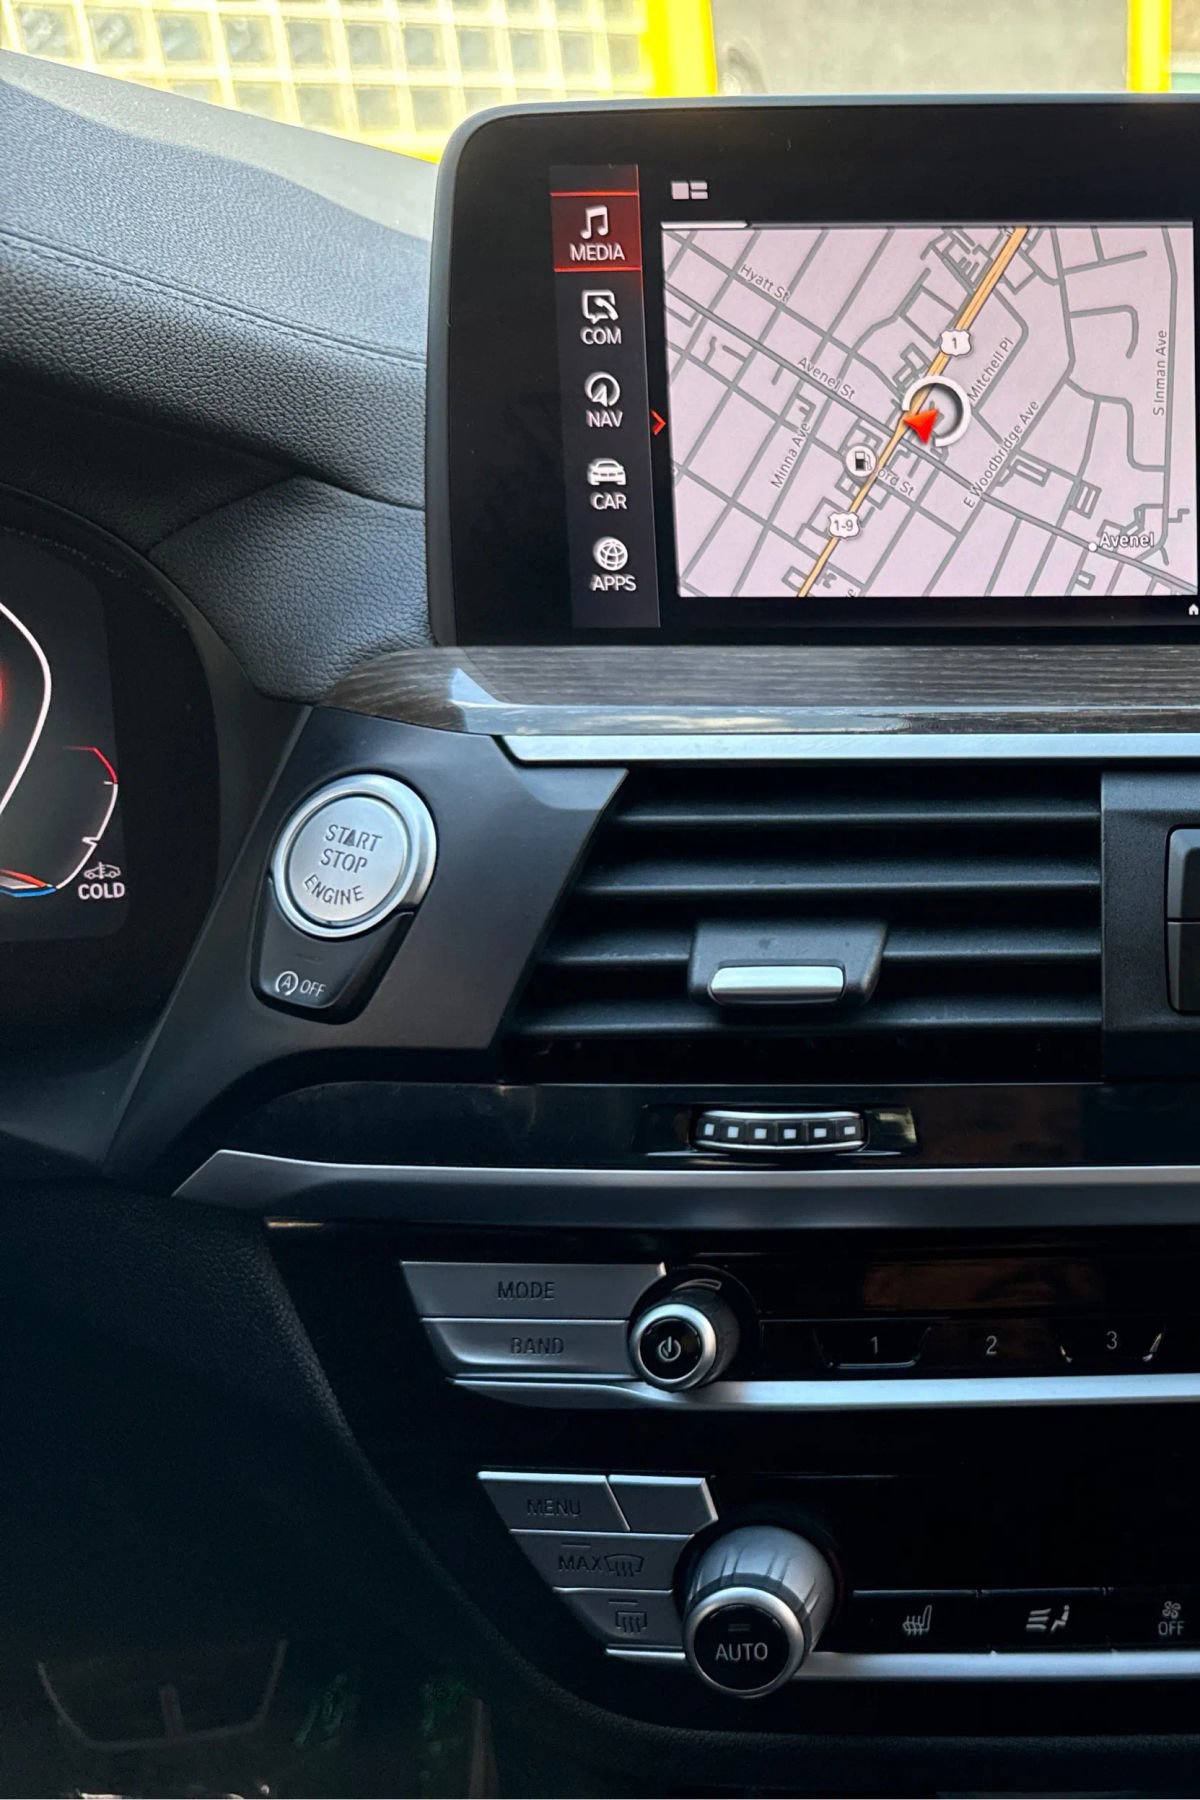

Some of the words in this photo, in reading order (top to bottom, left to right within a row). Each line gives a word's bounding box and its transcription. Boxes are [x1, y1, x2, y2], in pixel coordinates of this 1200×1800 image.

[569, 243, 626, 262] MEDIA
[739, 263, 773, 292] Hyatt
[770, 284, 790, 302] St
[580, 327, 622, 345] COM
[951, 336, 958, 350] 1
[1155, 329, 1168, 357] Ave
[797, 356, 841, 391] Avenel
[838, 384, 856, 401] St
[966, 352, 1004, 402] Mitchell
[999, 337, 1014, 351] Pl
[1154, 359, 1166, 405] Inman
[586, 410, 624, 428] NAV
[1019, 400, 1040, 426] Ave
[1152, 406, 1165, 416] S
[770, 449, 797, 489] Minna
[794, 421, 811, 448] Ave
[968, 424, 1023, 500] Woodbridge
[899, 481, 916, 497] St
[590, 494, 628, 511] CAR
[963, 497, 976, 509] E
[833, 519, 854, 532] 1-9
[1099, 532, 1155, 548] Avenel
[590, 575, 637, 592] APPS
[324, 824, 383, 852] START
[319, 848, 368, 874] STOP
[77, 882, 126, 901] COLD
[303, 873, 365, 906] ENGINE
[300, 979, 327, 998] OFF
[497, 1281, 556, 1300] MODE
[510, 1337, 565, 1356] BAND
[869, 1336, 879, 1354] 1
[985, 1335, 998, 1356] 2
[1106, 1331, 1118, 1350] 3
[527, 1498, 582, 1517] MENU
[557, 1554, 602, 1573] MAX
[1158, 1620, 1185, 1636] OFF
[715, 1642, 769, 1661] AUTO
